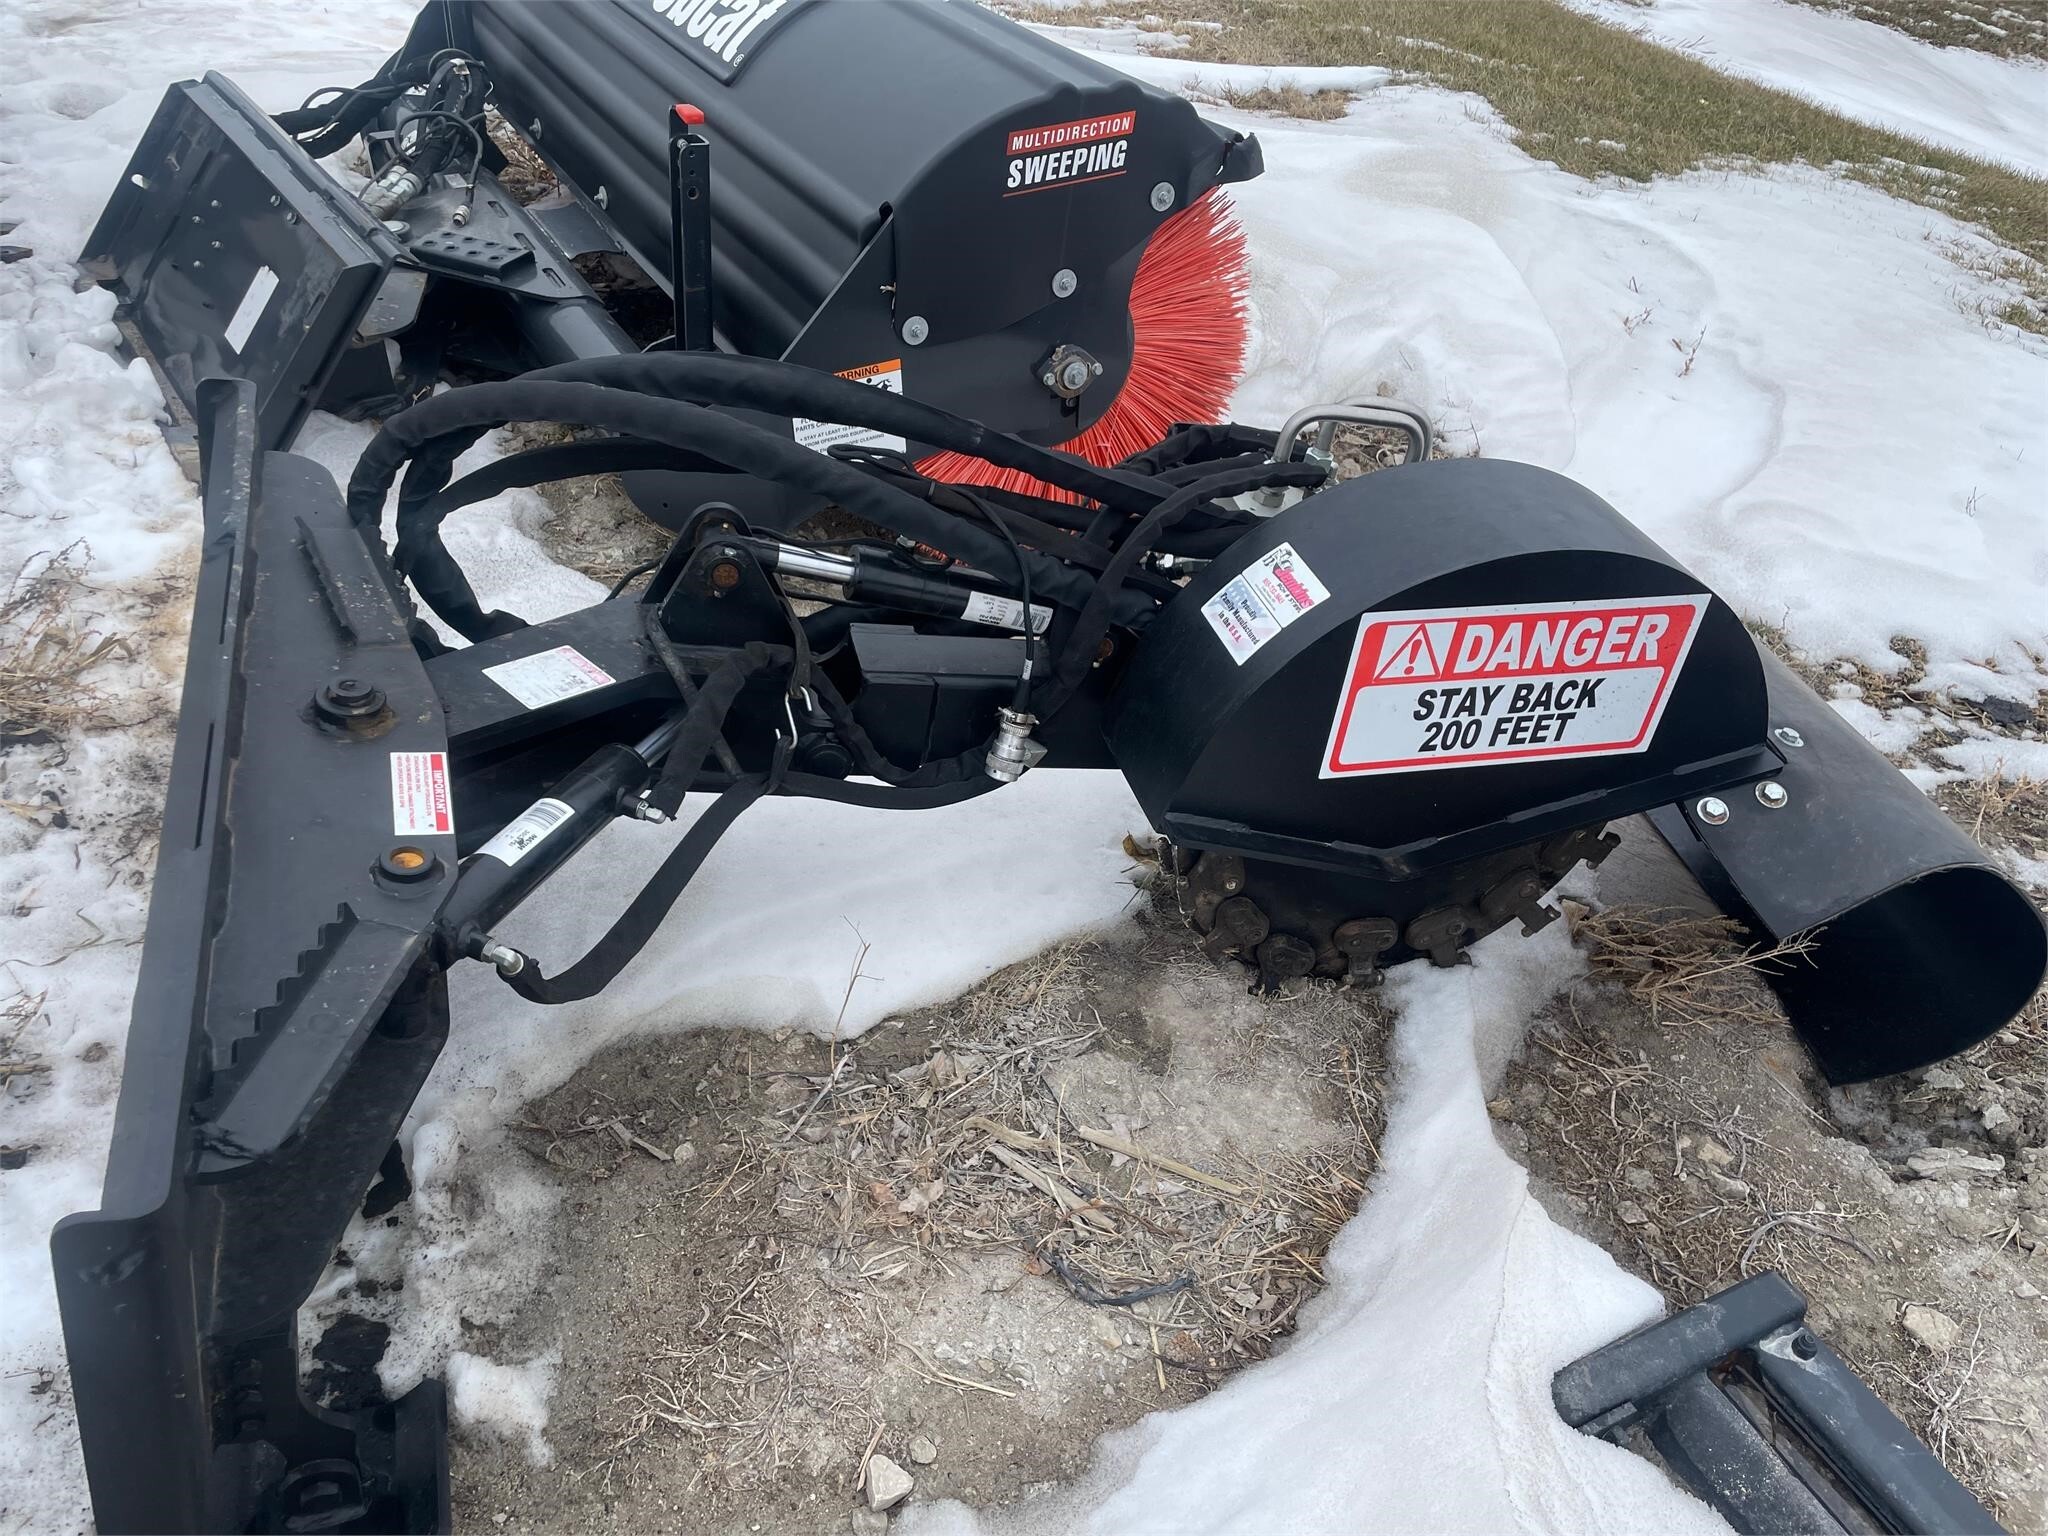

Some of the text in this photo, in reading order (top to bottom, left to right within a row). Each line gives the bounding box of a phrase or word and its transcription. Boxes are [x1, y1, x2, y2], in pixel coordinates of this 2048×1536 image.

[652, 0, 788, 63] cat
[1012, 116, 1131, 151] MULTIDIRECTION
[1007, 140, 1128, 188] SWEEPING
[838, 365, 880, 380] ARNING
[795, 423, 815, 432] PARTS
[804, 433, 817, 441] STAY
[825, 428, 841, 436] LEAST
[821, 433, 849, 444] OPERATING
[1218, 610, 1227, 619] in
[1220, 591, 1260, 645] Family Manufactured
[1222, 616, 1232, 627] the
[1240, 598, 1258, 621] Proudly
[1453, 613, 1671, 676] DANGER
[1413, 677, 1607, 721] STAY BACK
[1418, 711, 1577, 752] 200 FEET
[432, 769, 447, 815] IMPORTANT
